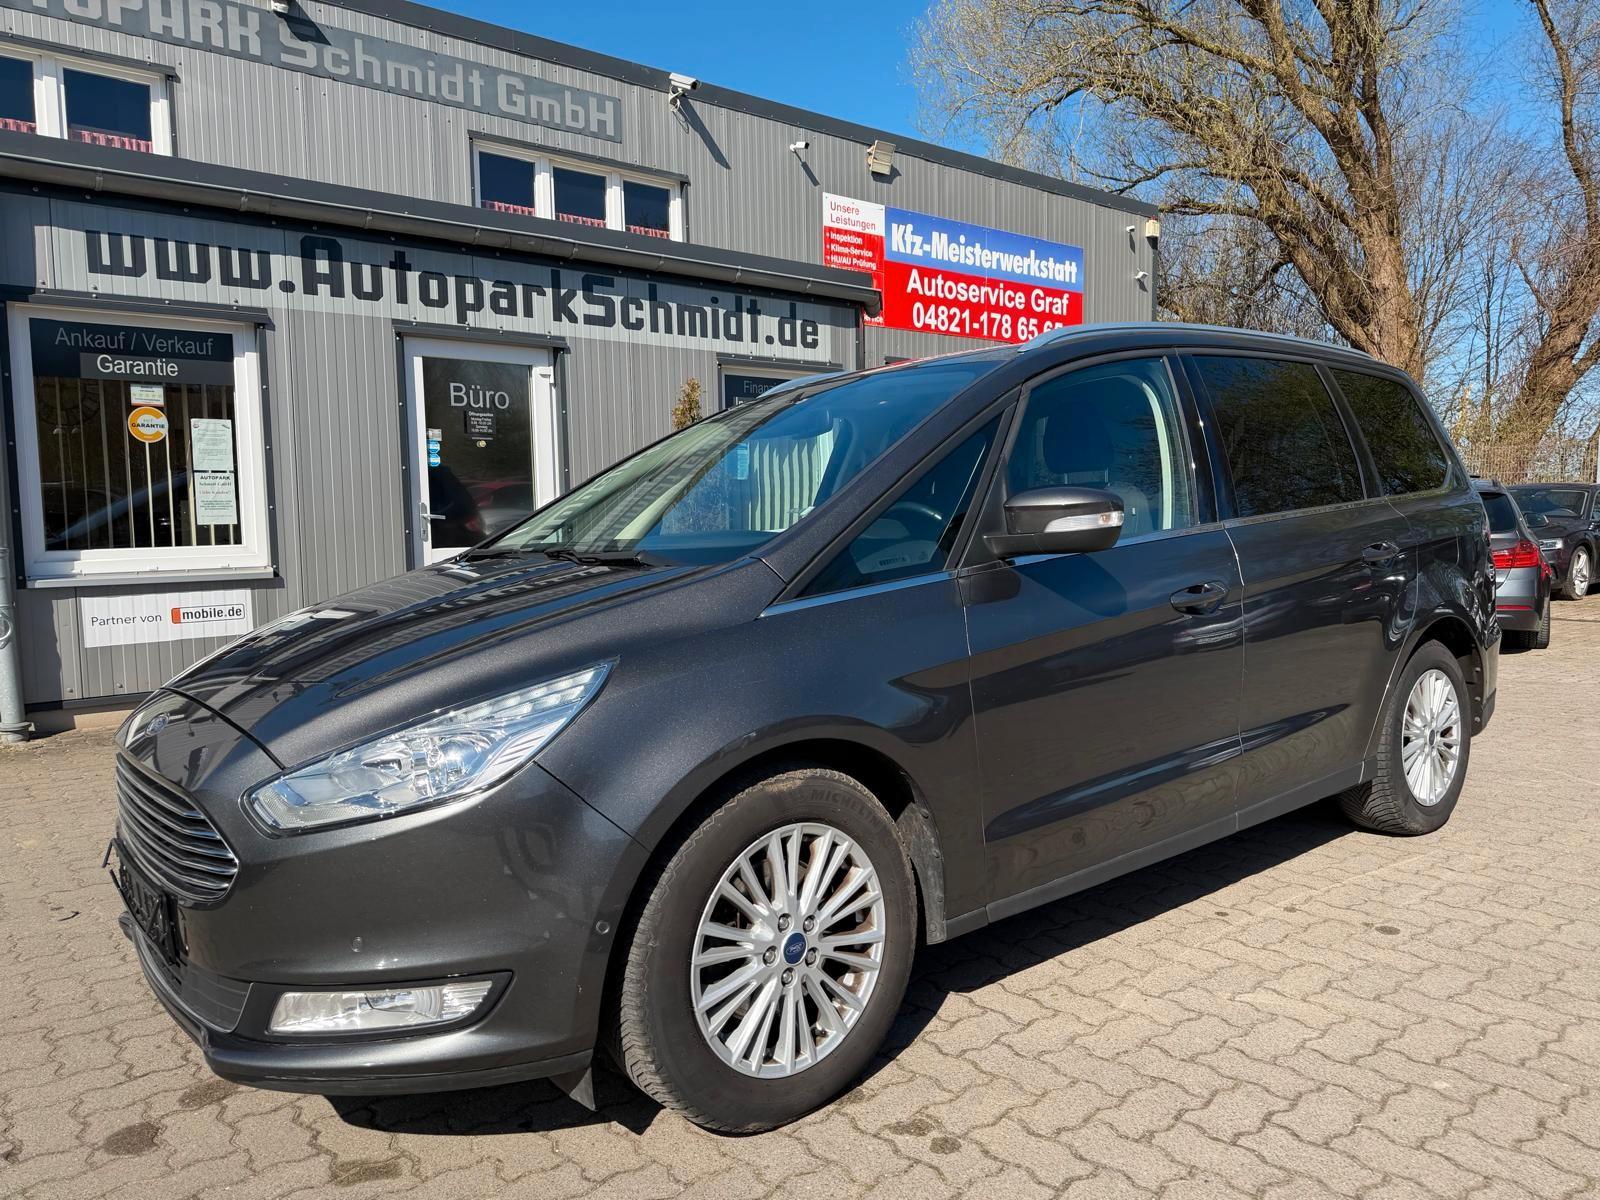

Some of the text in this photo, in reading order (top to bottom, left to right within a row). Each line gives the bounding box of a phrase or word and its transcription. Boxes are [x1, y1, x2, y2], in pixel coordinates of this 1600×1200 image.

[279, 20, 485, 107] Schmidt
[498, 74, 616, 138] GmbH
[830, 201, 860, 216] Unsere
[830, 213, 876, 231] Leistungen
[830, 231, 863, 245] Inspektion
[830, 243, 873, 258] Klima-Service
[831, 255, 852, 265] HU/AU
[852, 257, 877, 271] Prüfung
[891, 223, 1078, 284] Kfz-Meisterwerkstatt
[86, 229, 820, 350] www.AutoparkSchmidt.de
[906, 268, 1070, 316] Autoservice Graf
[912, 301, 1012, 339] 04821-178
[1017, 316, 1038, 341] 65
[55, 327, 215, 355] Ankauf / Verkauf
[97, 354, 179, 377] Garantie
[449, 382, 510, 409] Büro
[91, 606, 243, 627] Partner von mobile.de
[810, 789, 881, 828] MICHELIN
